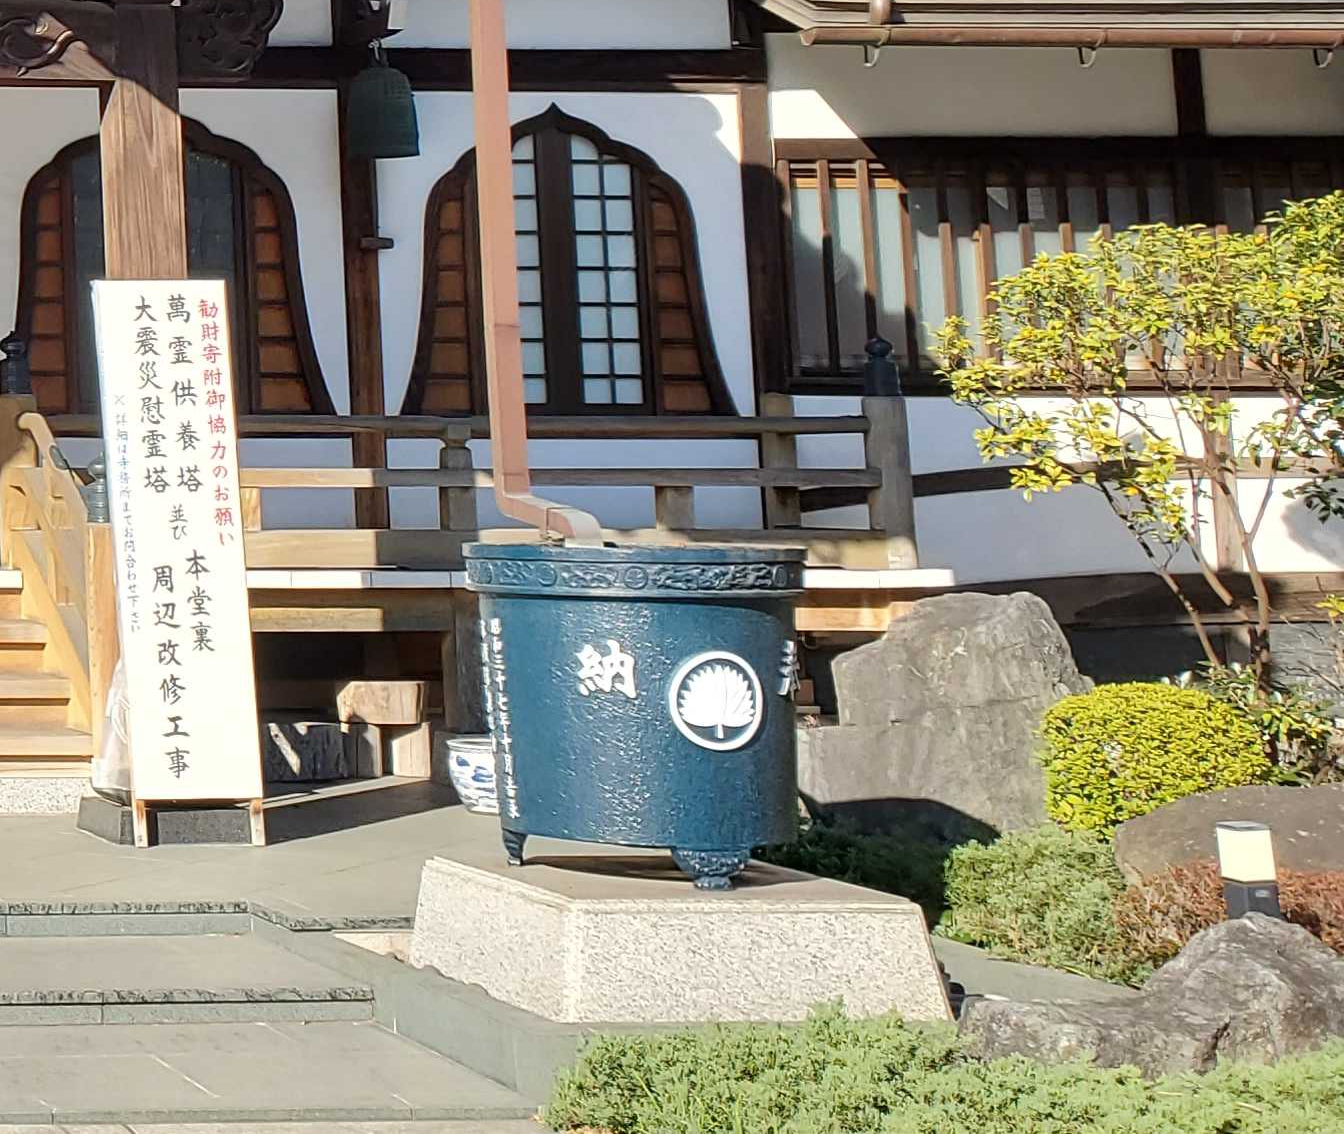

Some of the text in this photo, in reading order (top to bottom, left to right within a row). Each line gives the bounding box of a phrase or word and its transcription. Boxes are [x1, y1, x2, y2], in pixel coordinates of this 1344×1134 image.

[152, 564, 190, 779] 周辺改修工事
[576, 639, 638, 699] 納
